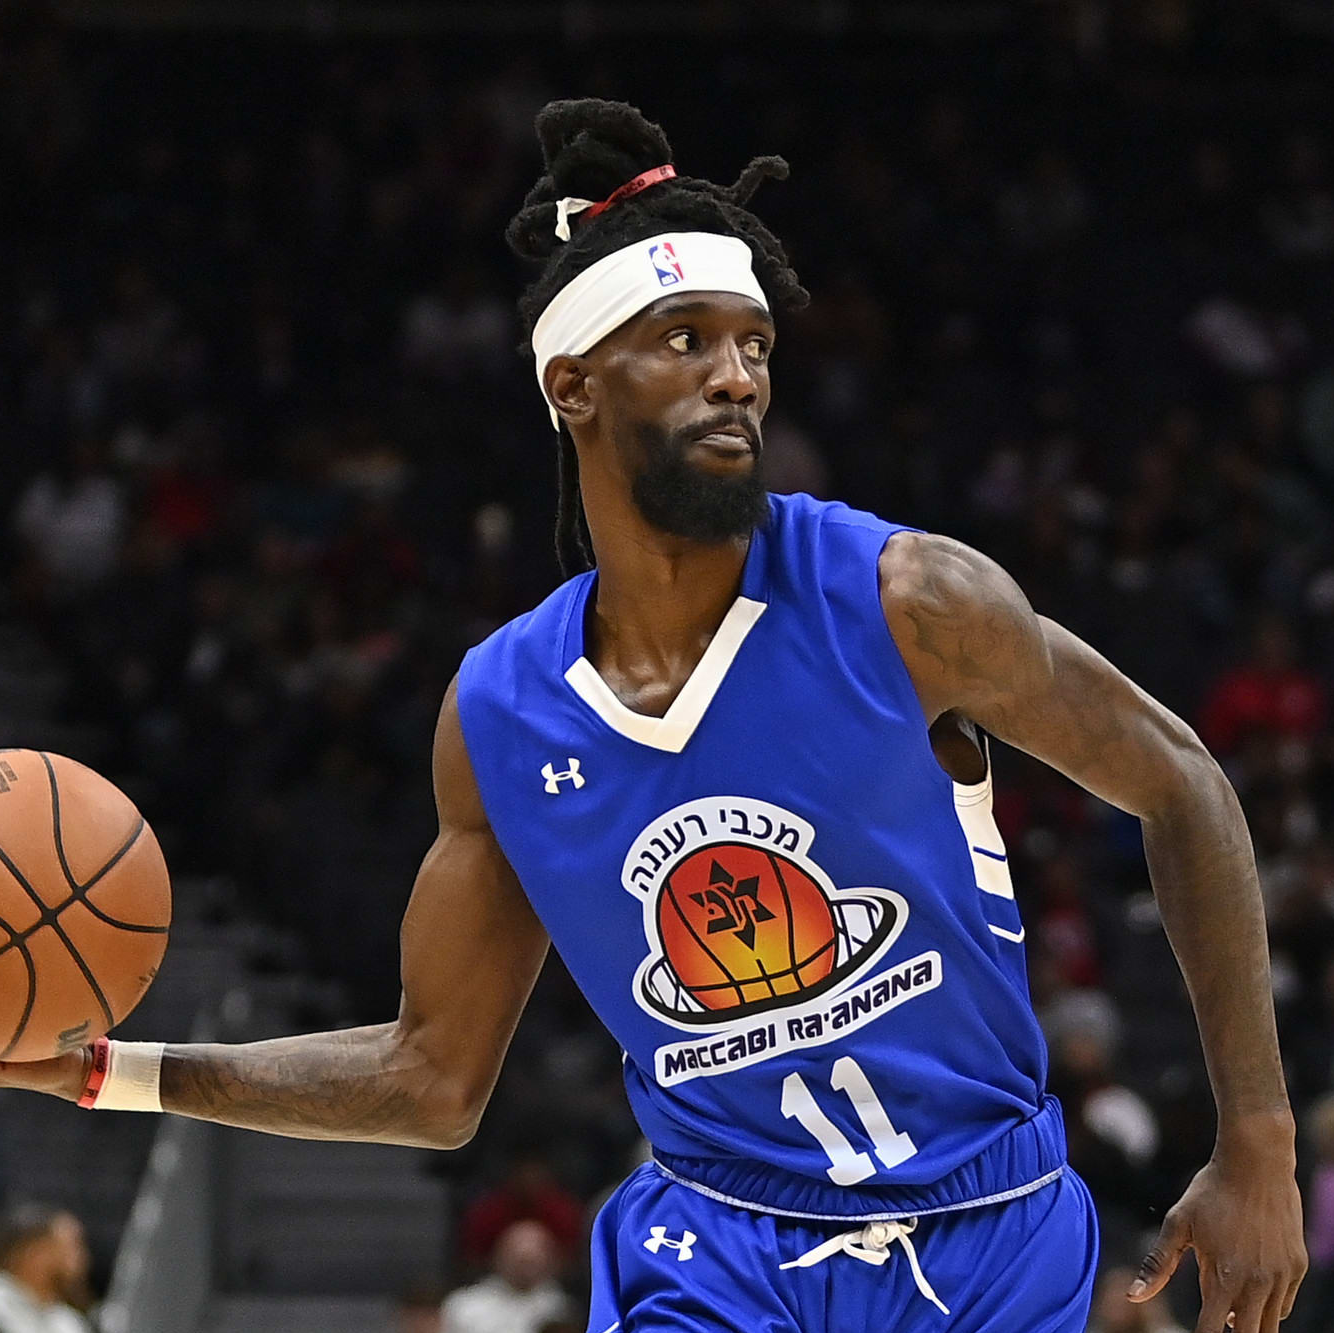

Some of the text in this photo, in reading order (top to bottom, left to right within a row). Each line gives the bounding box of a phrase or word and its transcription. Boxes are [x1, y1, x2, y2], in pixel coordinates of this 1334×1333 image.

[630, 808, 801, 893] מכבי רעננה
[780, 1055, 919, 1187] 11
